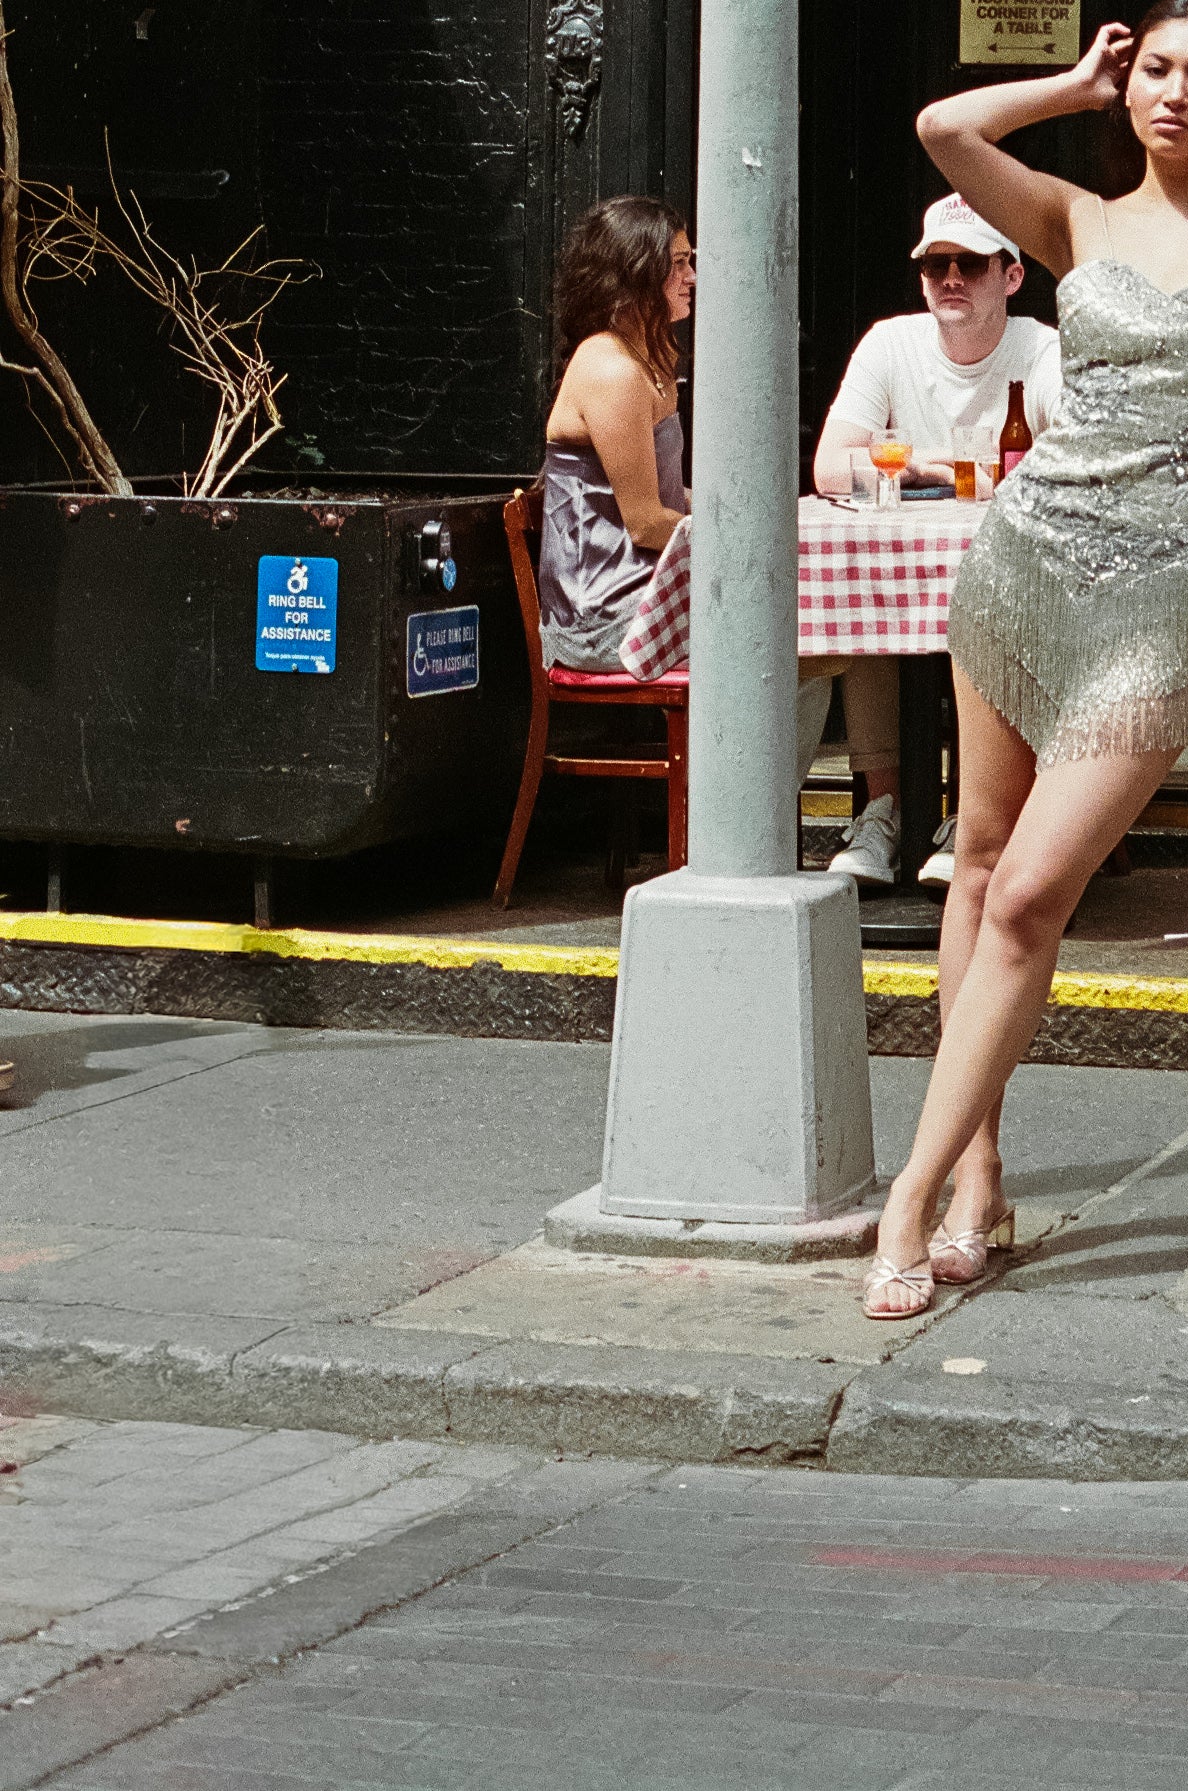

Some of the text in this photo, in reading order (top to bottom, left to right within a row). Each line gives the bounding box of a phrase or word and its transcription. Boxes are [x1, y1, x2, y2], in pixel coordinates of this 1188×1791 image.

[976, 6, 1069, 21] CORNER FOR
[993, 21, 1053, 35] A TABLE
[268, 594, 327, 609] RING BELL
[285, 611, 309, 624] FOR
[261, 626, 332, 642] ASSISTANCE
[426, 625, 475, 647] PLEASE RING BELL
[431, 653, 475, 674] FOR ASSISTANCE
